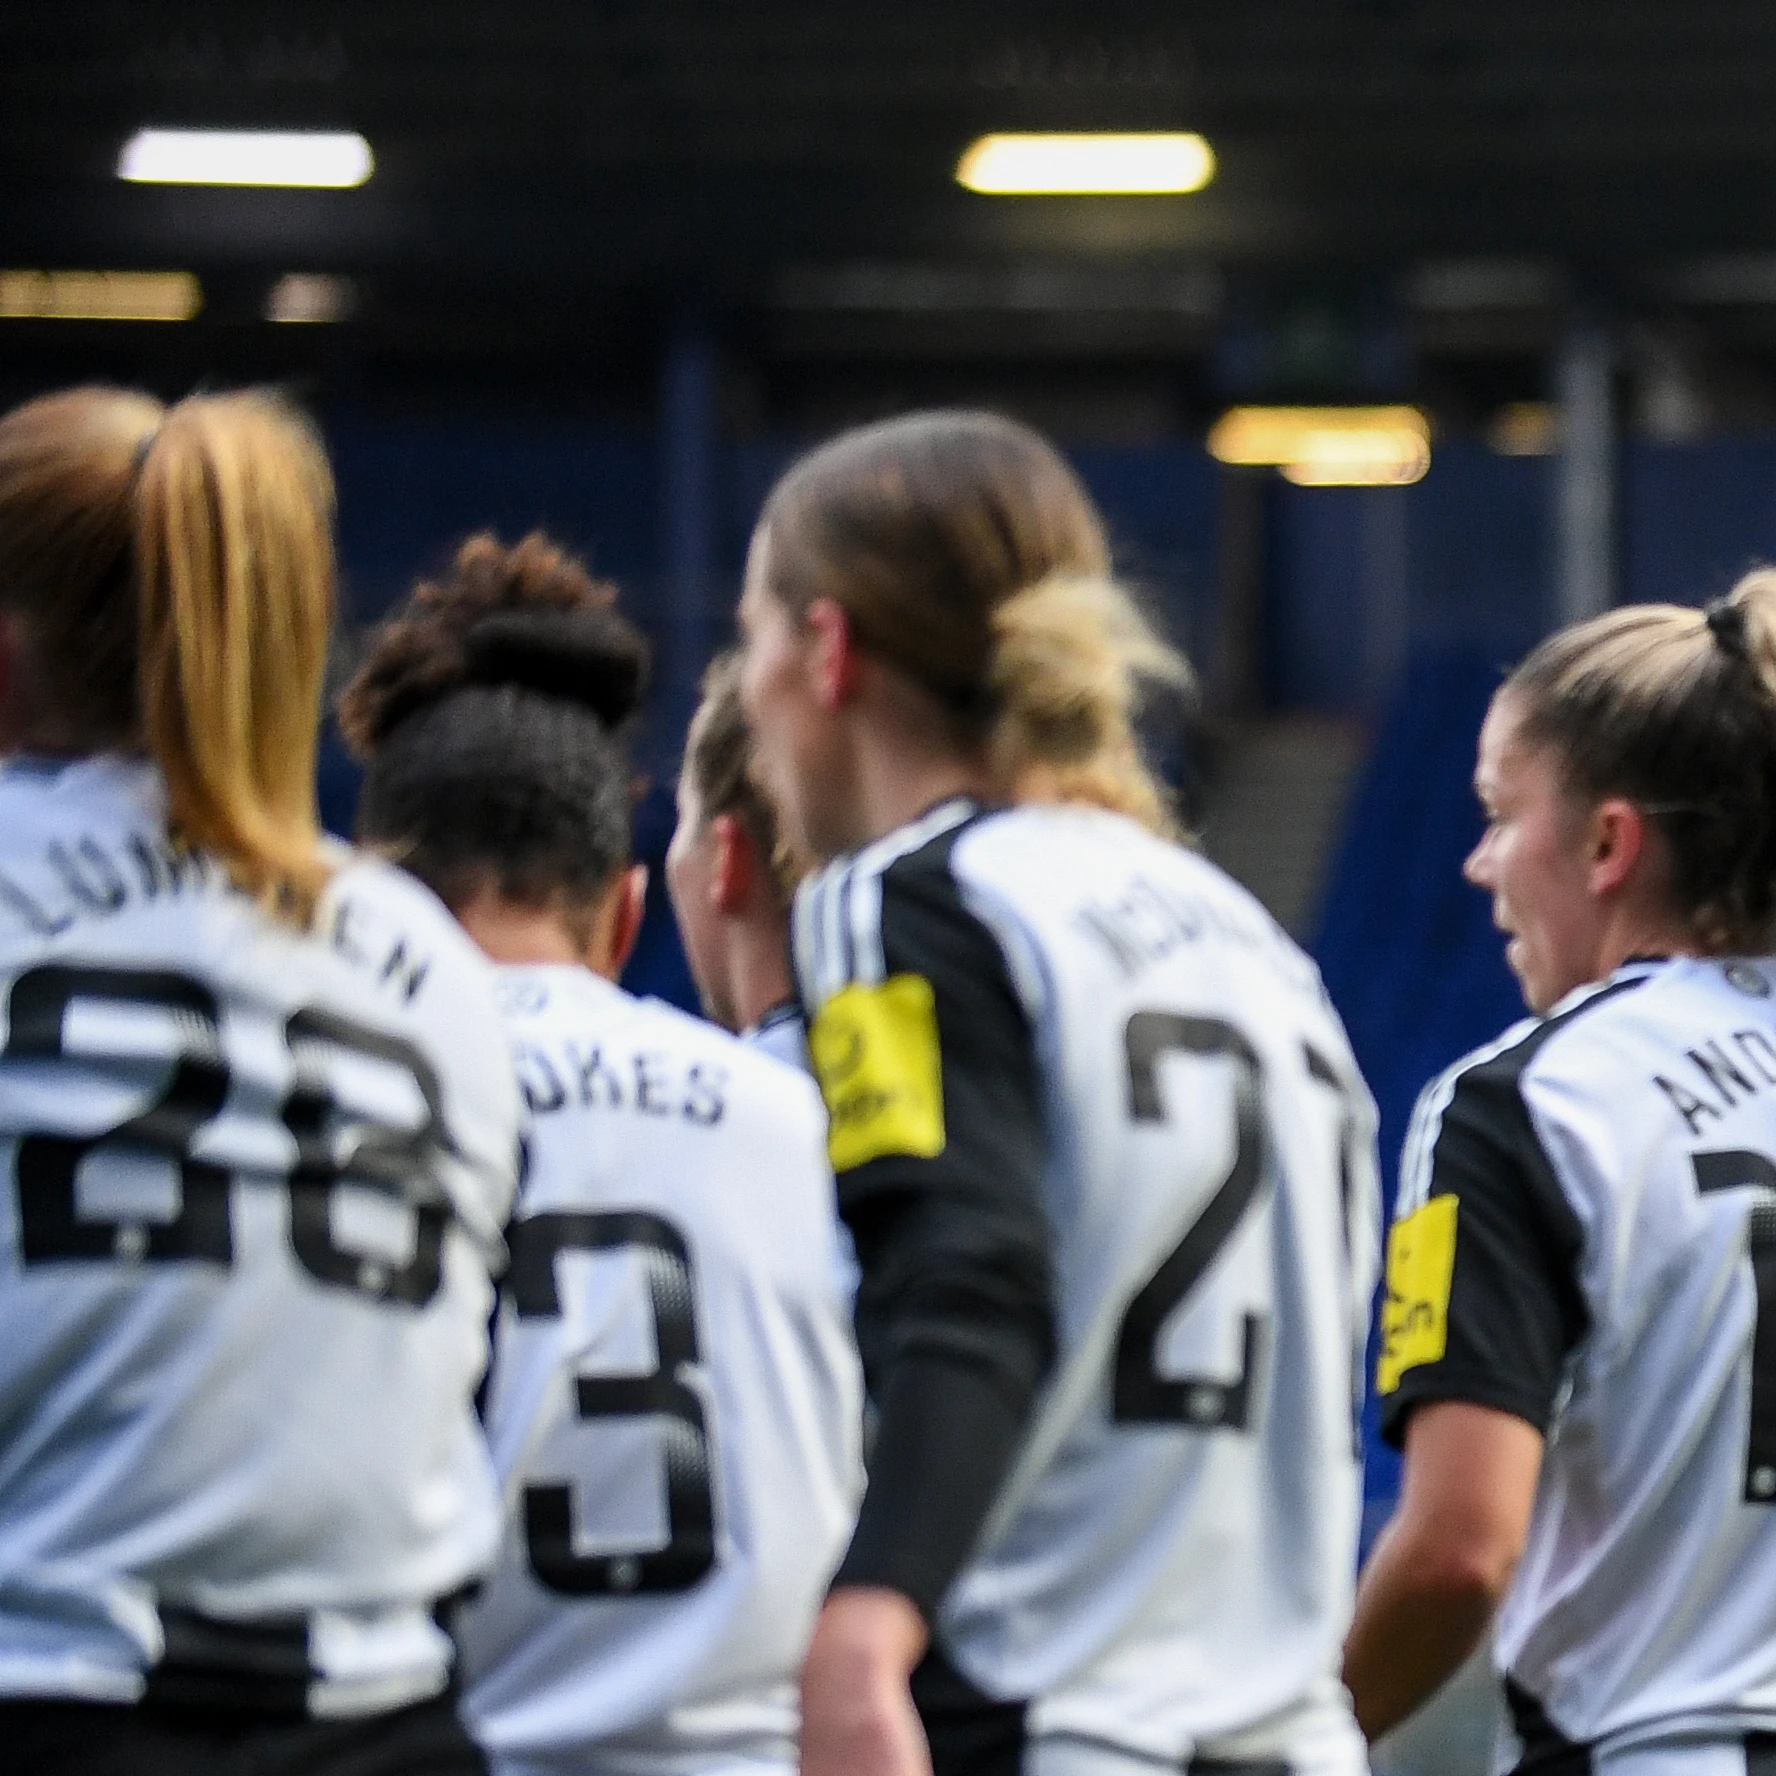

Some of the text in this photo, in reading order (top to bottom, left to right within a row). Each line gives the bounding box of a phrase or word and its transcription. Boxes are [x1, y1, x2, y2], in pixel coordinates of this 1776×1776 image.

[1, 832, 430, 1004] LUMEN
[515, 1040, 730, 1127] OKES
[506, 1210, 716, 1597] 3
